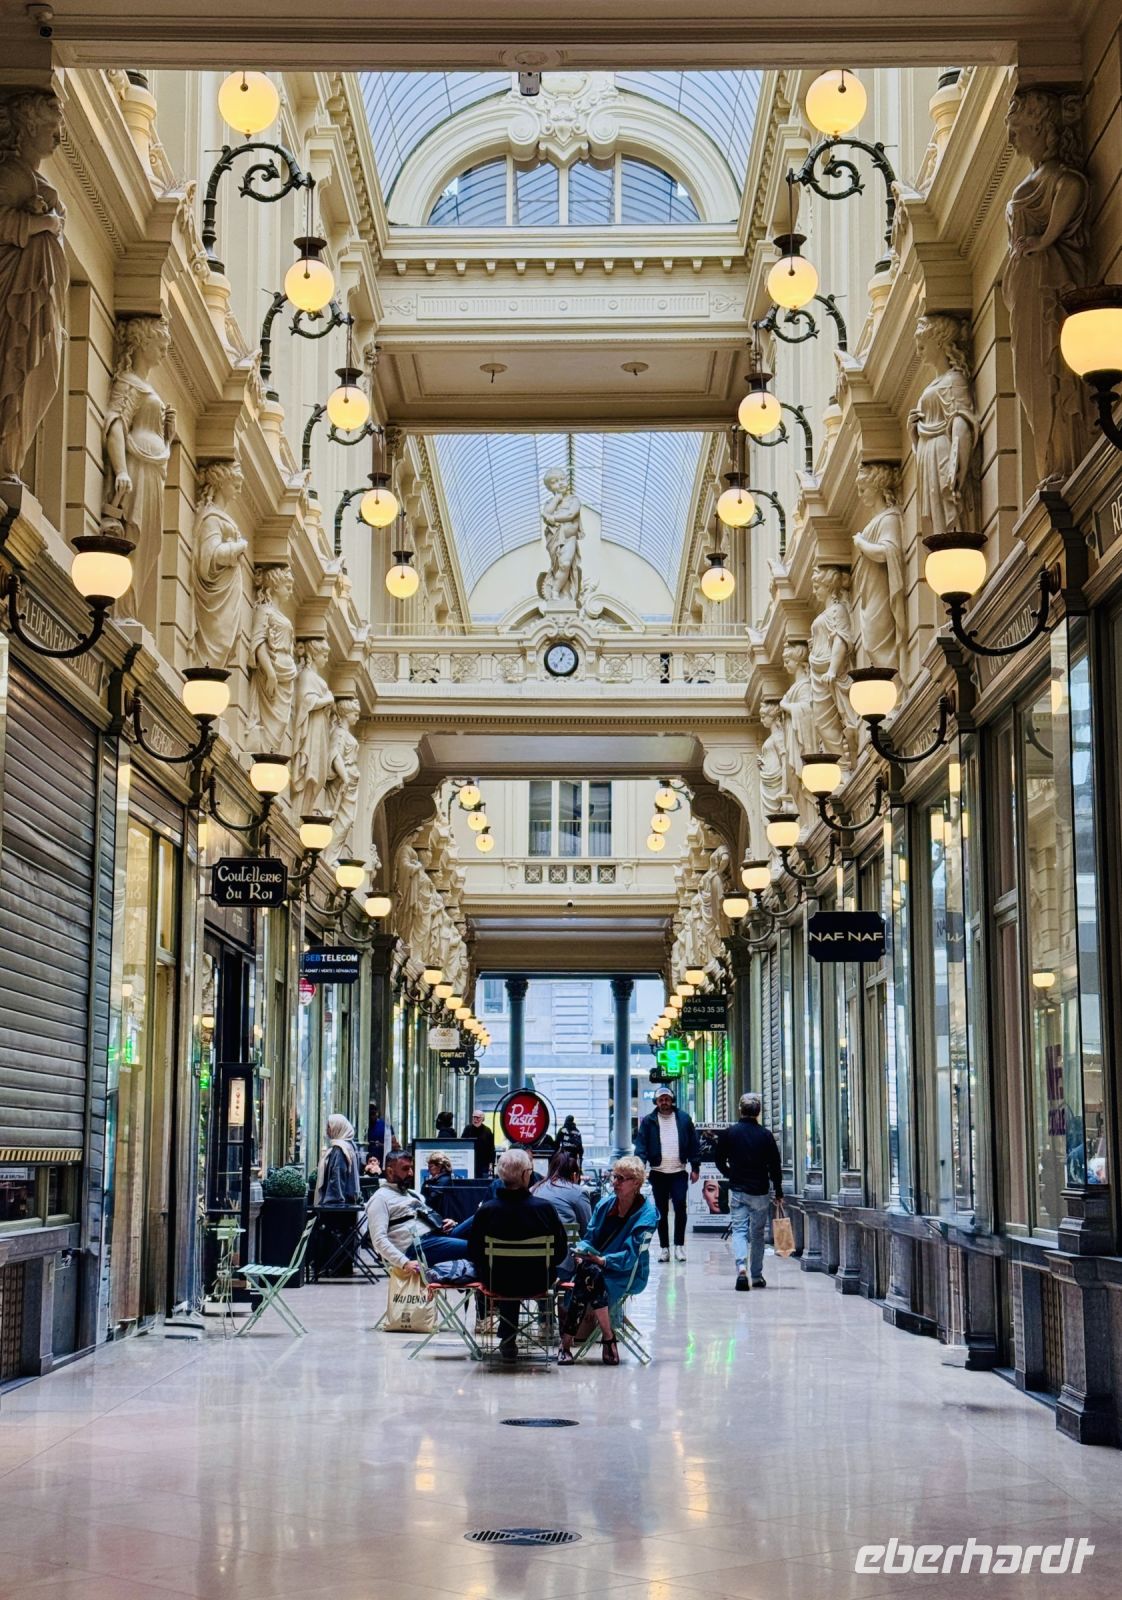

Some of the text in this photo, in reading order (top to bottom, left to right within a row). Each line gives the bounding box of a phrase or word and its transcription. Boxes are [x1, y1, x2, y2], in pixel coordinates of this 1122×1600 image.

[226, 882, 273, 900] du Roi
[809, 931, 884, 942] NAF NAF
